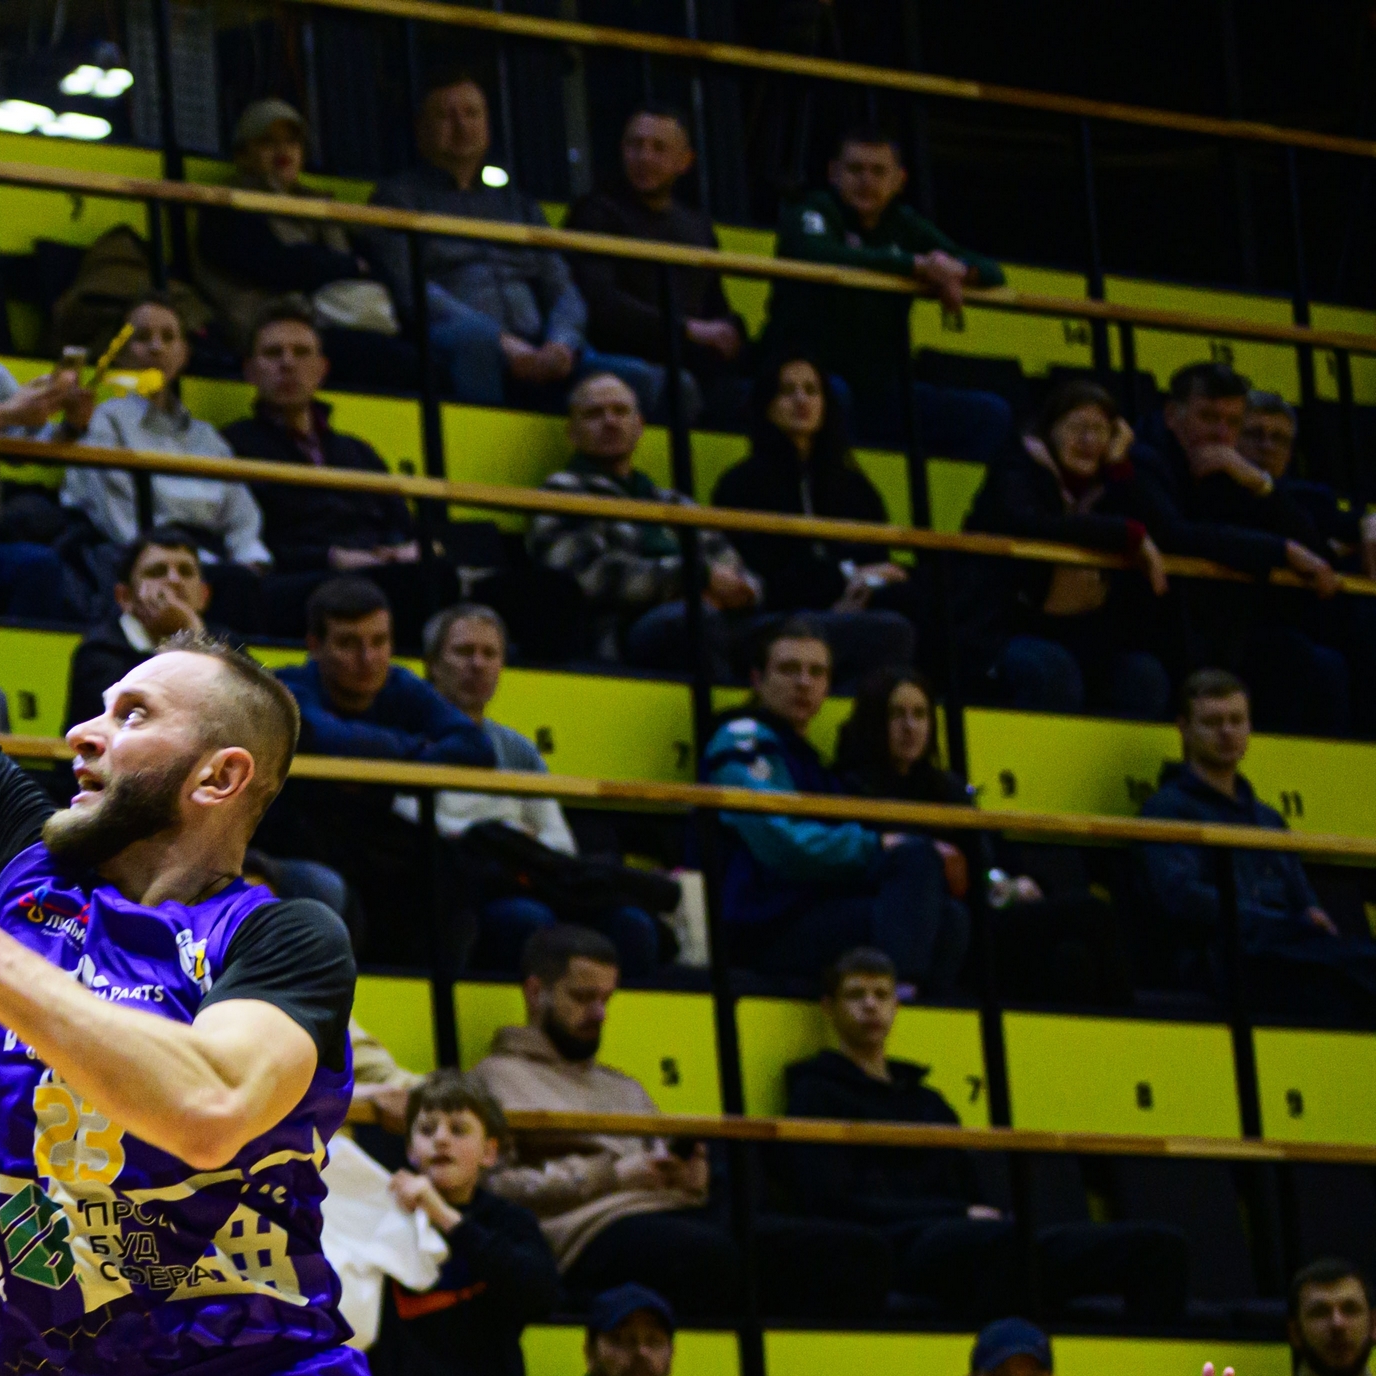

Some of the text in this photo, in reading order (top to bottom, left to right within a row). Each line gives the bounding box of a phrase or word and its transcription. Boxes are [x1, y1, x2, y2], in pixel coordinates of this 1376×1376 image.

[110, 984, 164, 1003] PARTS
[33, 1083, 126, 1187] 23
[89, 1231, 160, 1264] БУД
